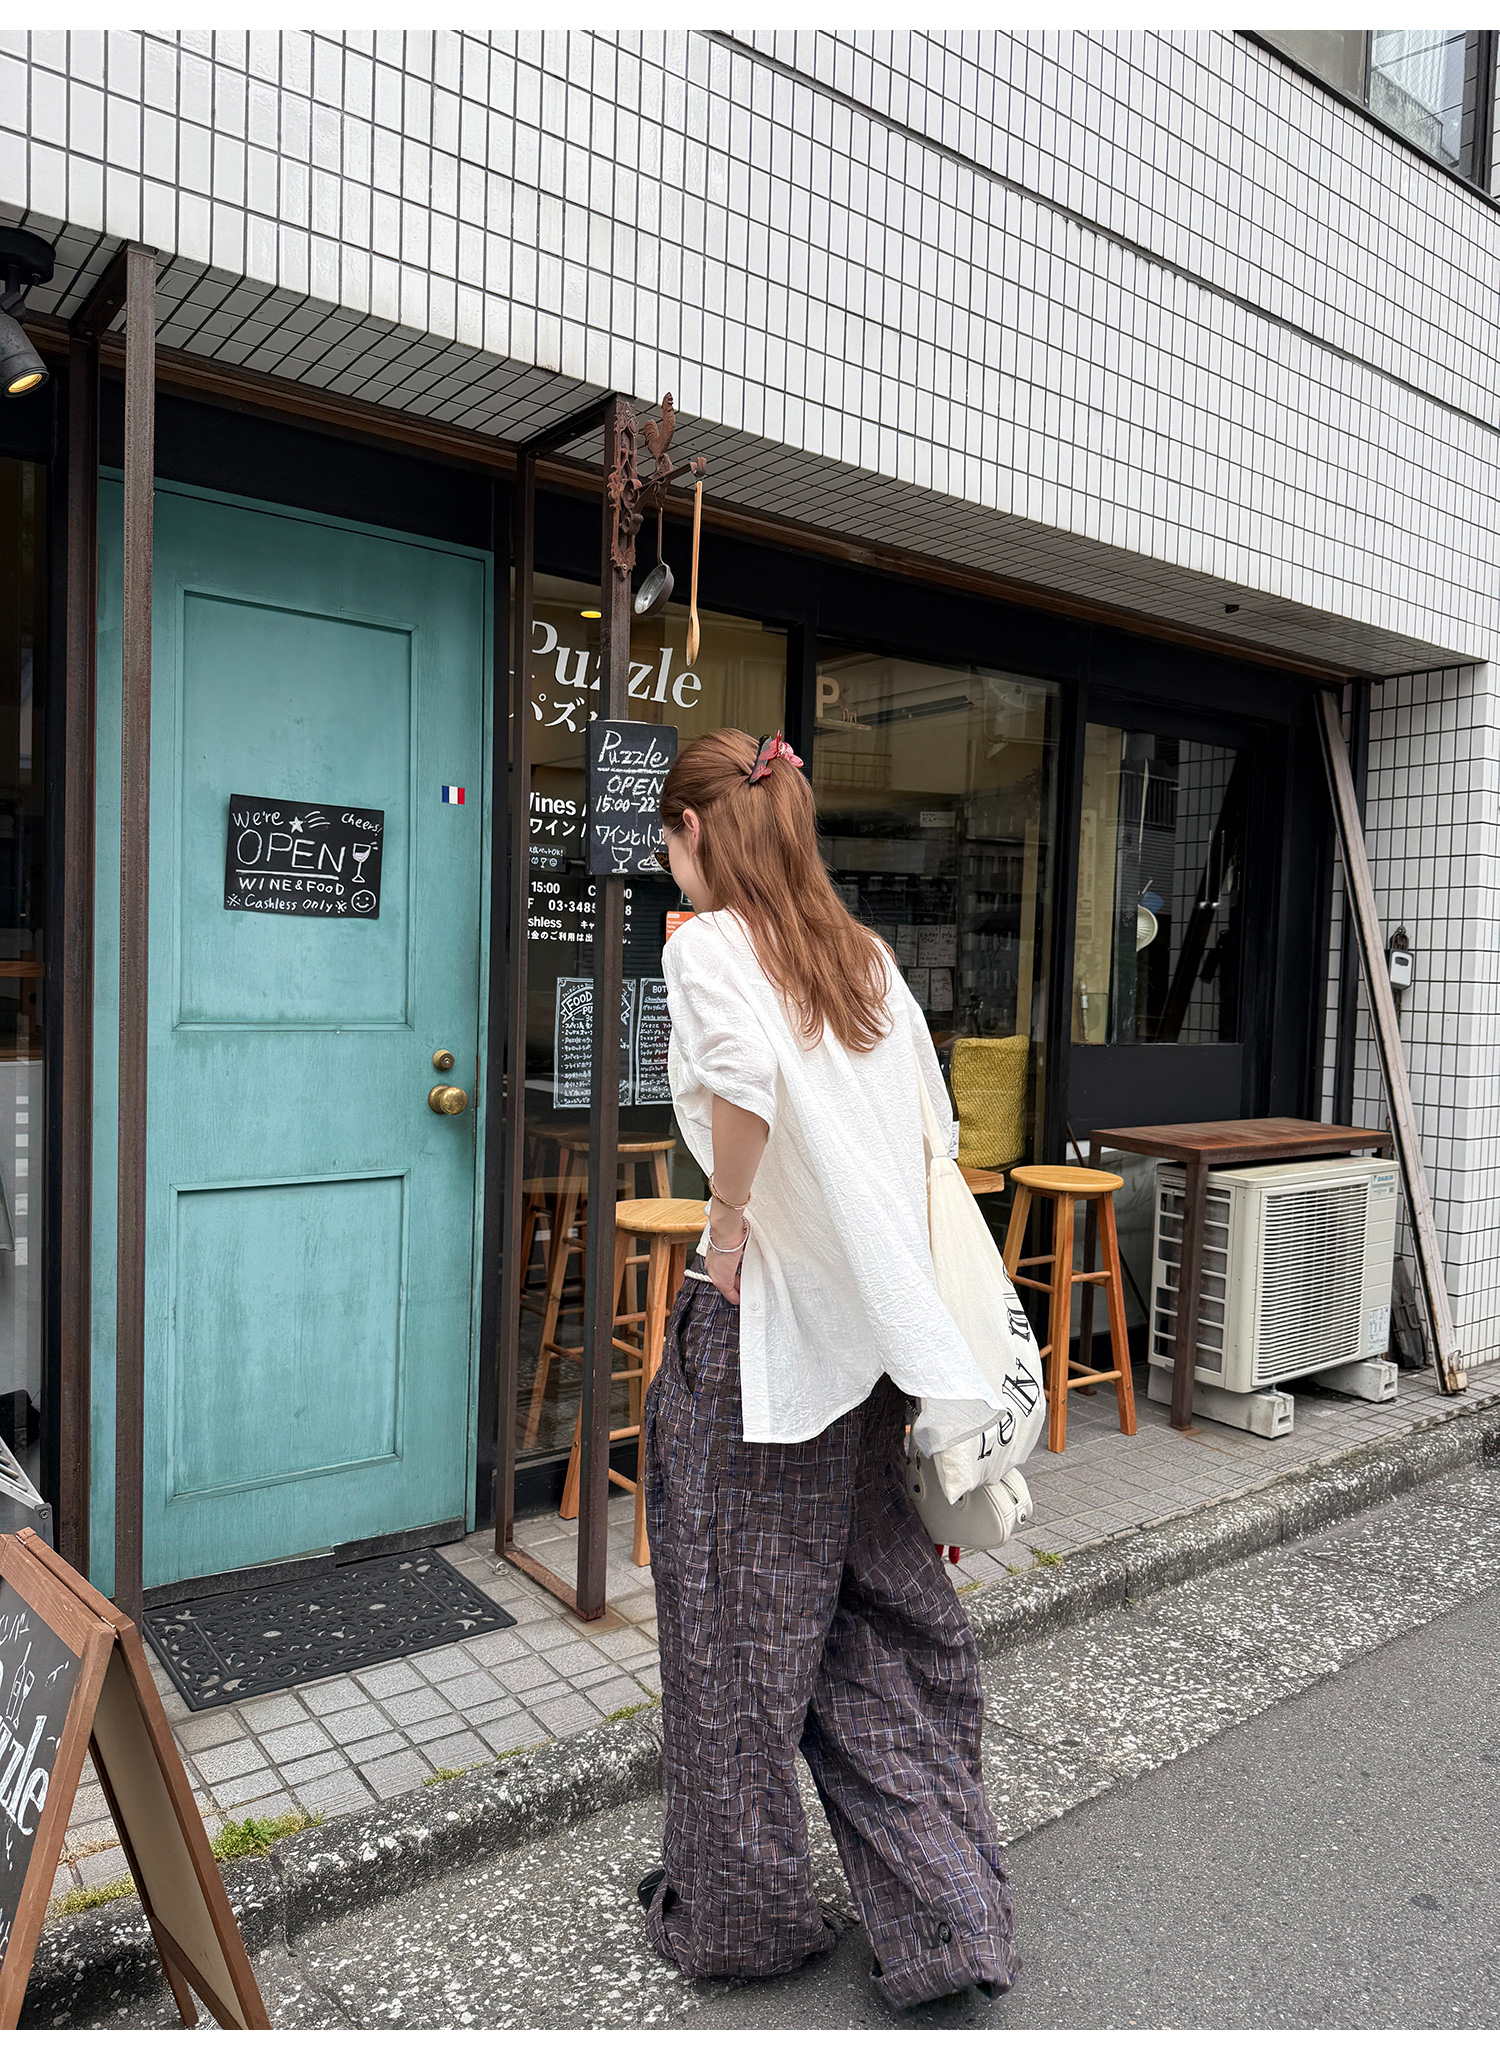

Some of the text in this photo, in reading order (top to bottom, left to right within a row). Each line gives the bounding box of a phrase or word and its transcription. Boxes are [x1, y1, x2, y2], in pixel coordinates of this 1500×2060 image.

[510, 620, 702, 708] Puzle
[510, 692, 600, 733] パズ
[598, 730, 669, 768] Puzzle
[606, 775, 666, 796] OPEN
[232, 810, 384, 836] We're Cheers!
[236, 829, 346, 874] OPEN
[531, 880, 561, 895] 15:00
[527, 915, 562, 929] shless
[565, 990, 593, 1011] FOOD
